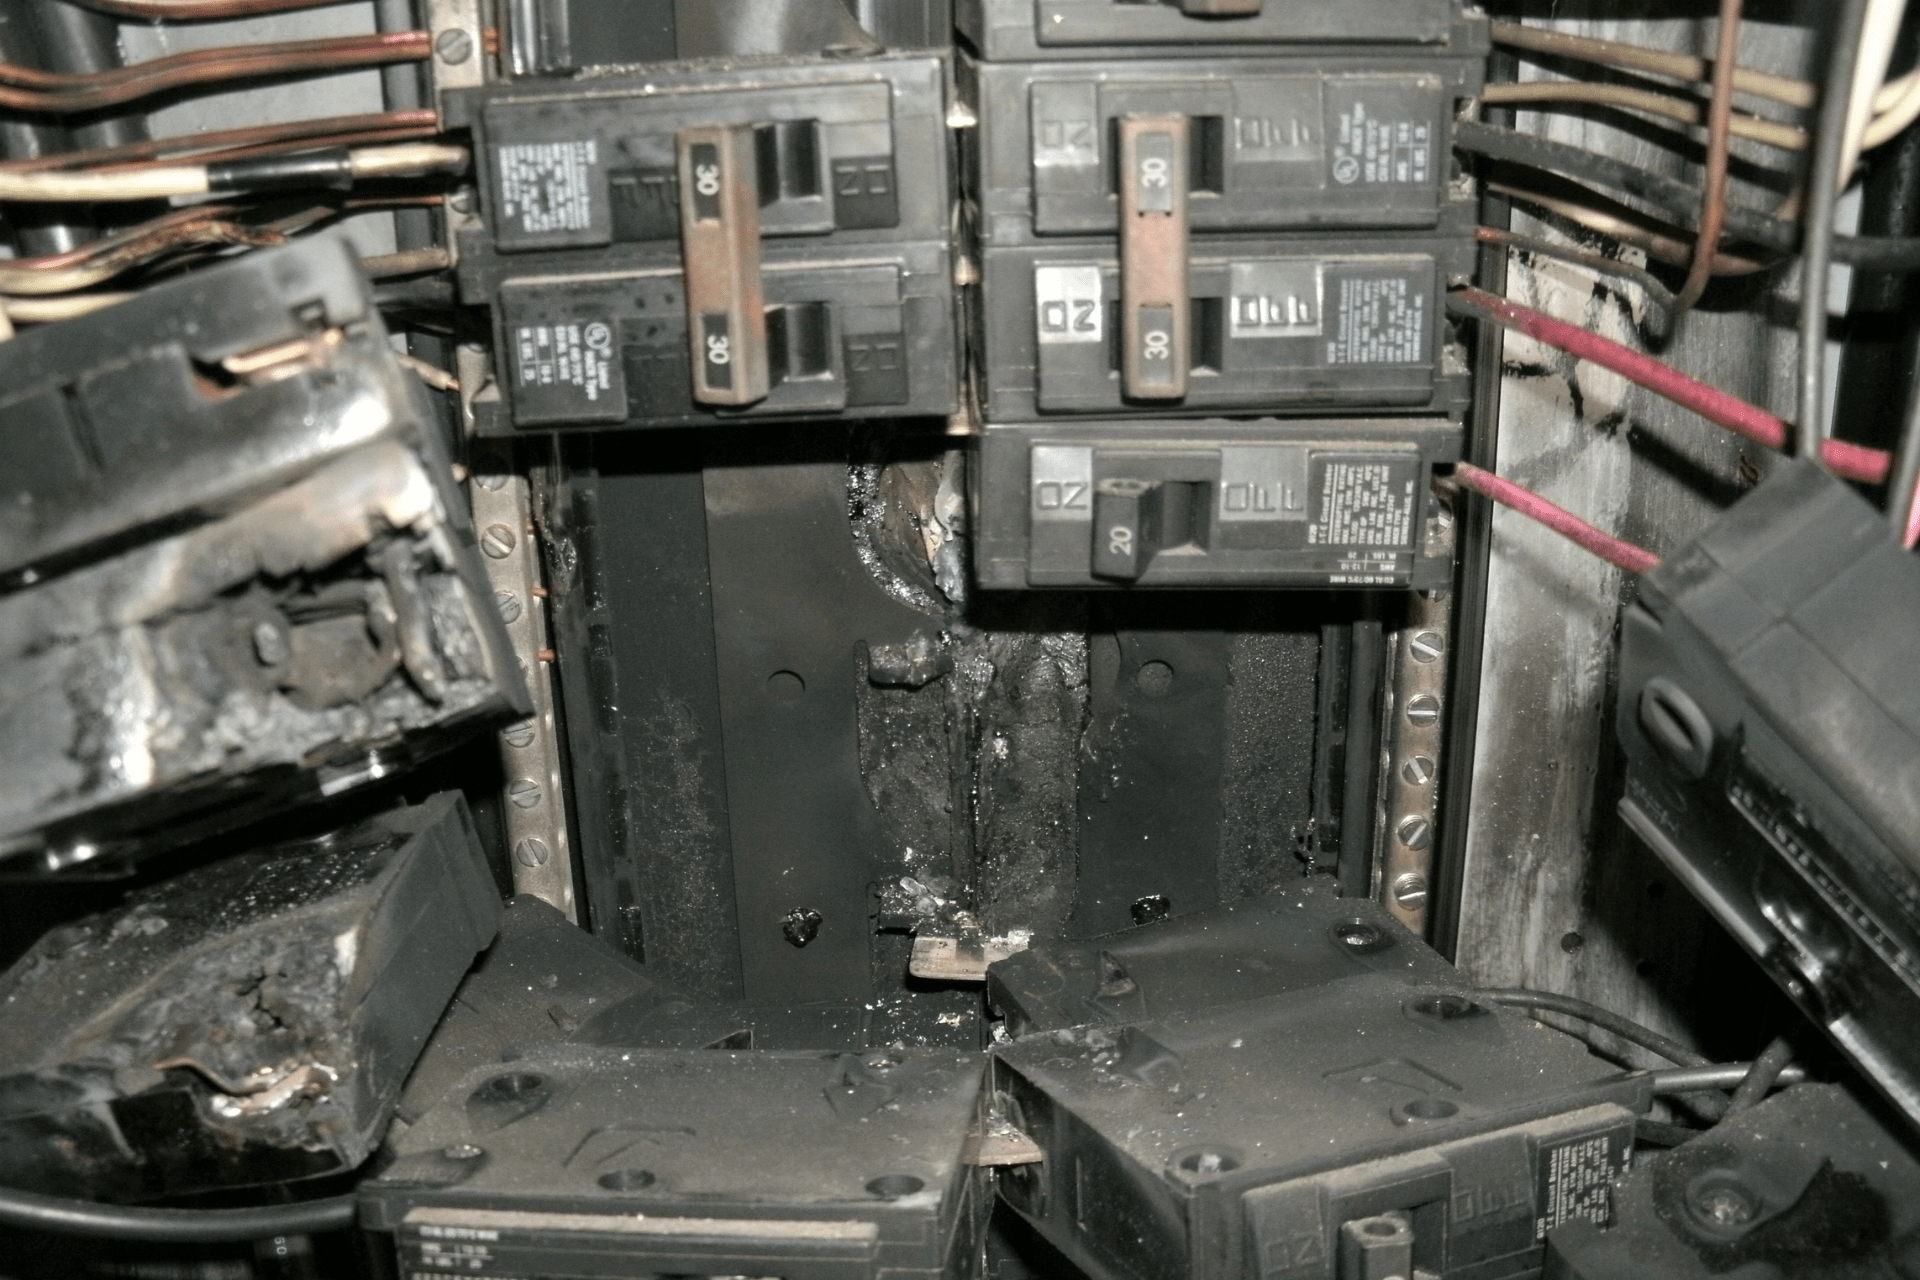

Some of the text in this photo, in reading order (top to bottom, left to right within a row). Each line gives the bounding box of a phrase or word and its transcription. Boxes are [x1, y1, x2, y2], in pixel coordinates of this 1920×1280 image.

[695, 164, 720, 196] 30
[1141, 156, 1166, 188] 30
[1041, 300, 1097, 332] ON
[706, 335, 729, 365] 30
[1144, 331, 1169, 360] 30
[1323, 464, 1333, 494] Breaker
[1036, 481, 1088, 510] ON
[1320, 496, 1330, 523] Circuit
[1109, 526, 1133, 556] 20
[1548, 1149, 1558, 1183] Breaker
[1562, 1146, 1571, 1174] RATING
[1546, 1184, 1556, 1213] Circuit
